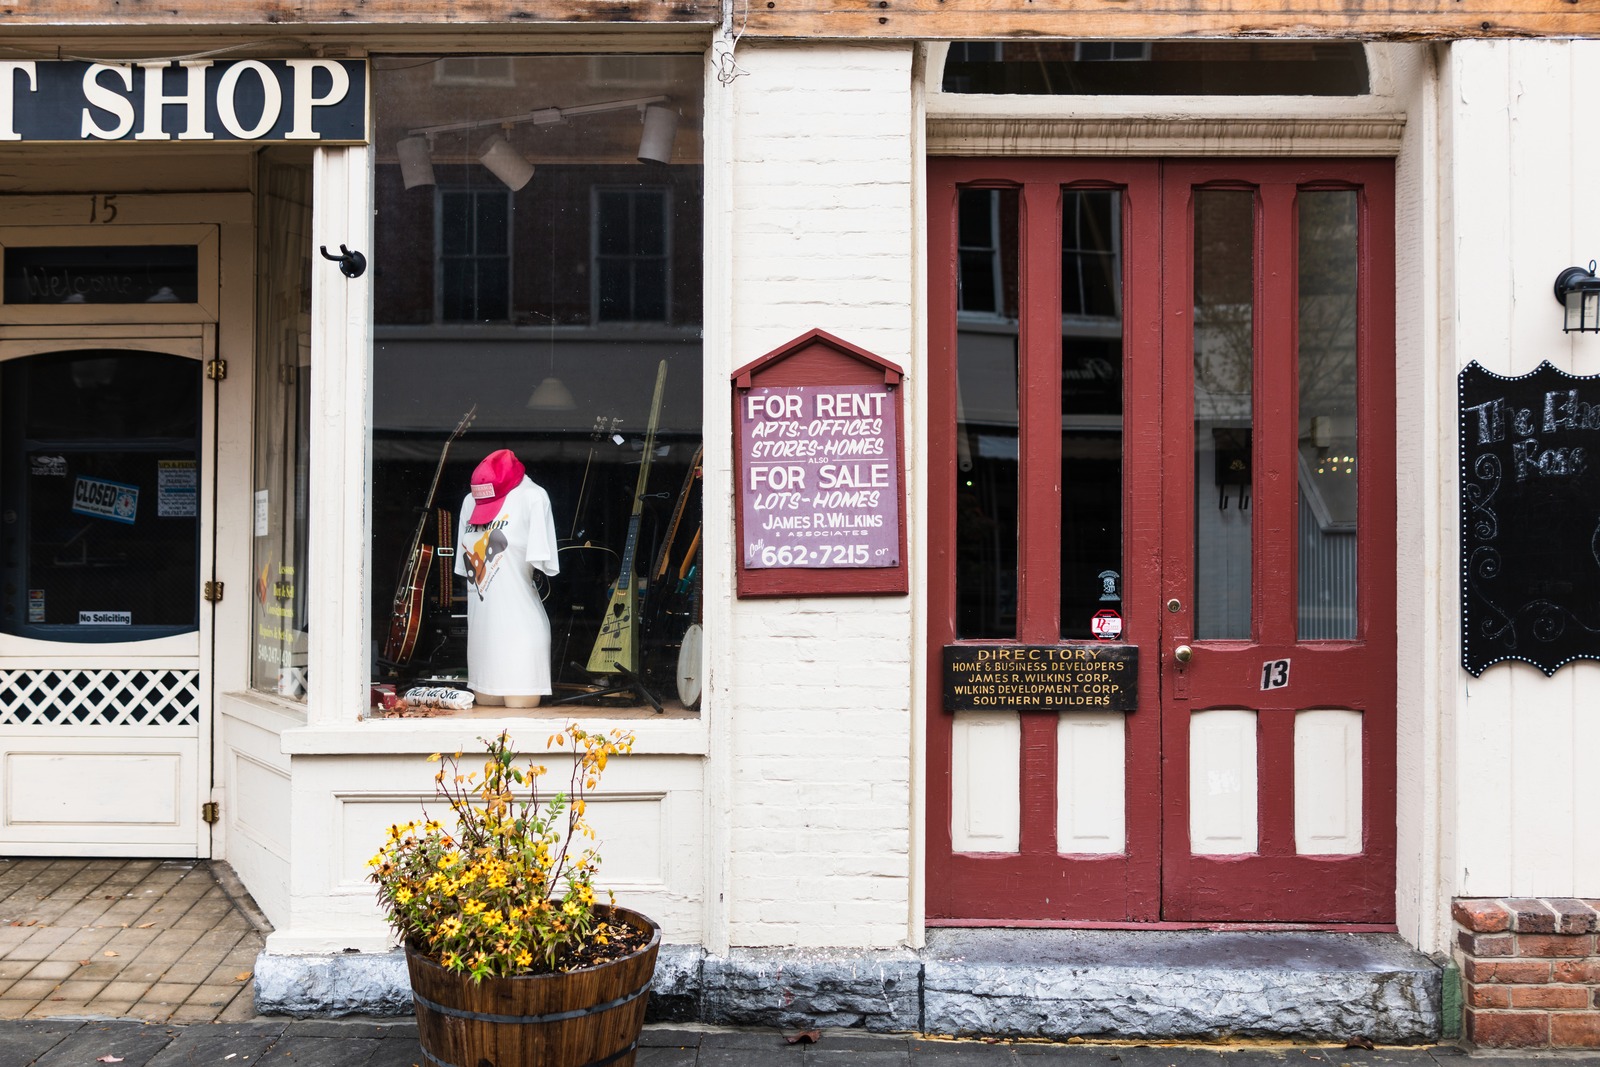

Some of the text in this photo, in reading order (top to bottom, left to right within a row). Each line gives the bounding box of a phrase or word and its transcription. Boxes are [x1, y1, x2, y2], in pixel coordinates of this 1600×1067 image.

[81, 60, 350, 140] SHOP
[90, 195, 118, 223] 15
[748, 393, 887, 419] FOR RENT
[1465, 397, 1535, 446] The
[1512, 438, 1588, 483] Rose
[750, 464, 889, 491] FOR SALE
[75, 480, 117, 508] CLOSED
[763, 514, 810, 530] JAMES
[750, 538, 764, 558] Call
[875, 547, 889, 556] or
[80, 613, 130, 624] No Soliciting
[952, 661, 1124, 671] HOME & BUSINESS DEVELOPERS
[978, 650, 1101, 660] DIRECTORY
[968, 674, 1009, 683] JAMES
[1076, 674, 1112, 683] CORP.
[1263, 660, 1289, 689] 13
[954, 684, 1124, 694] WILKINS DEVELOPMENT CORP.
[973, 695, 1110, 705] SOUTHERN BUILDERS
